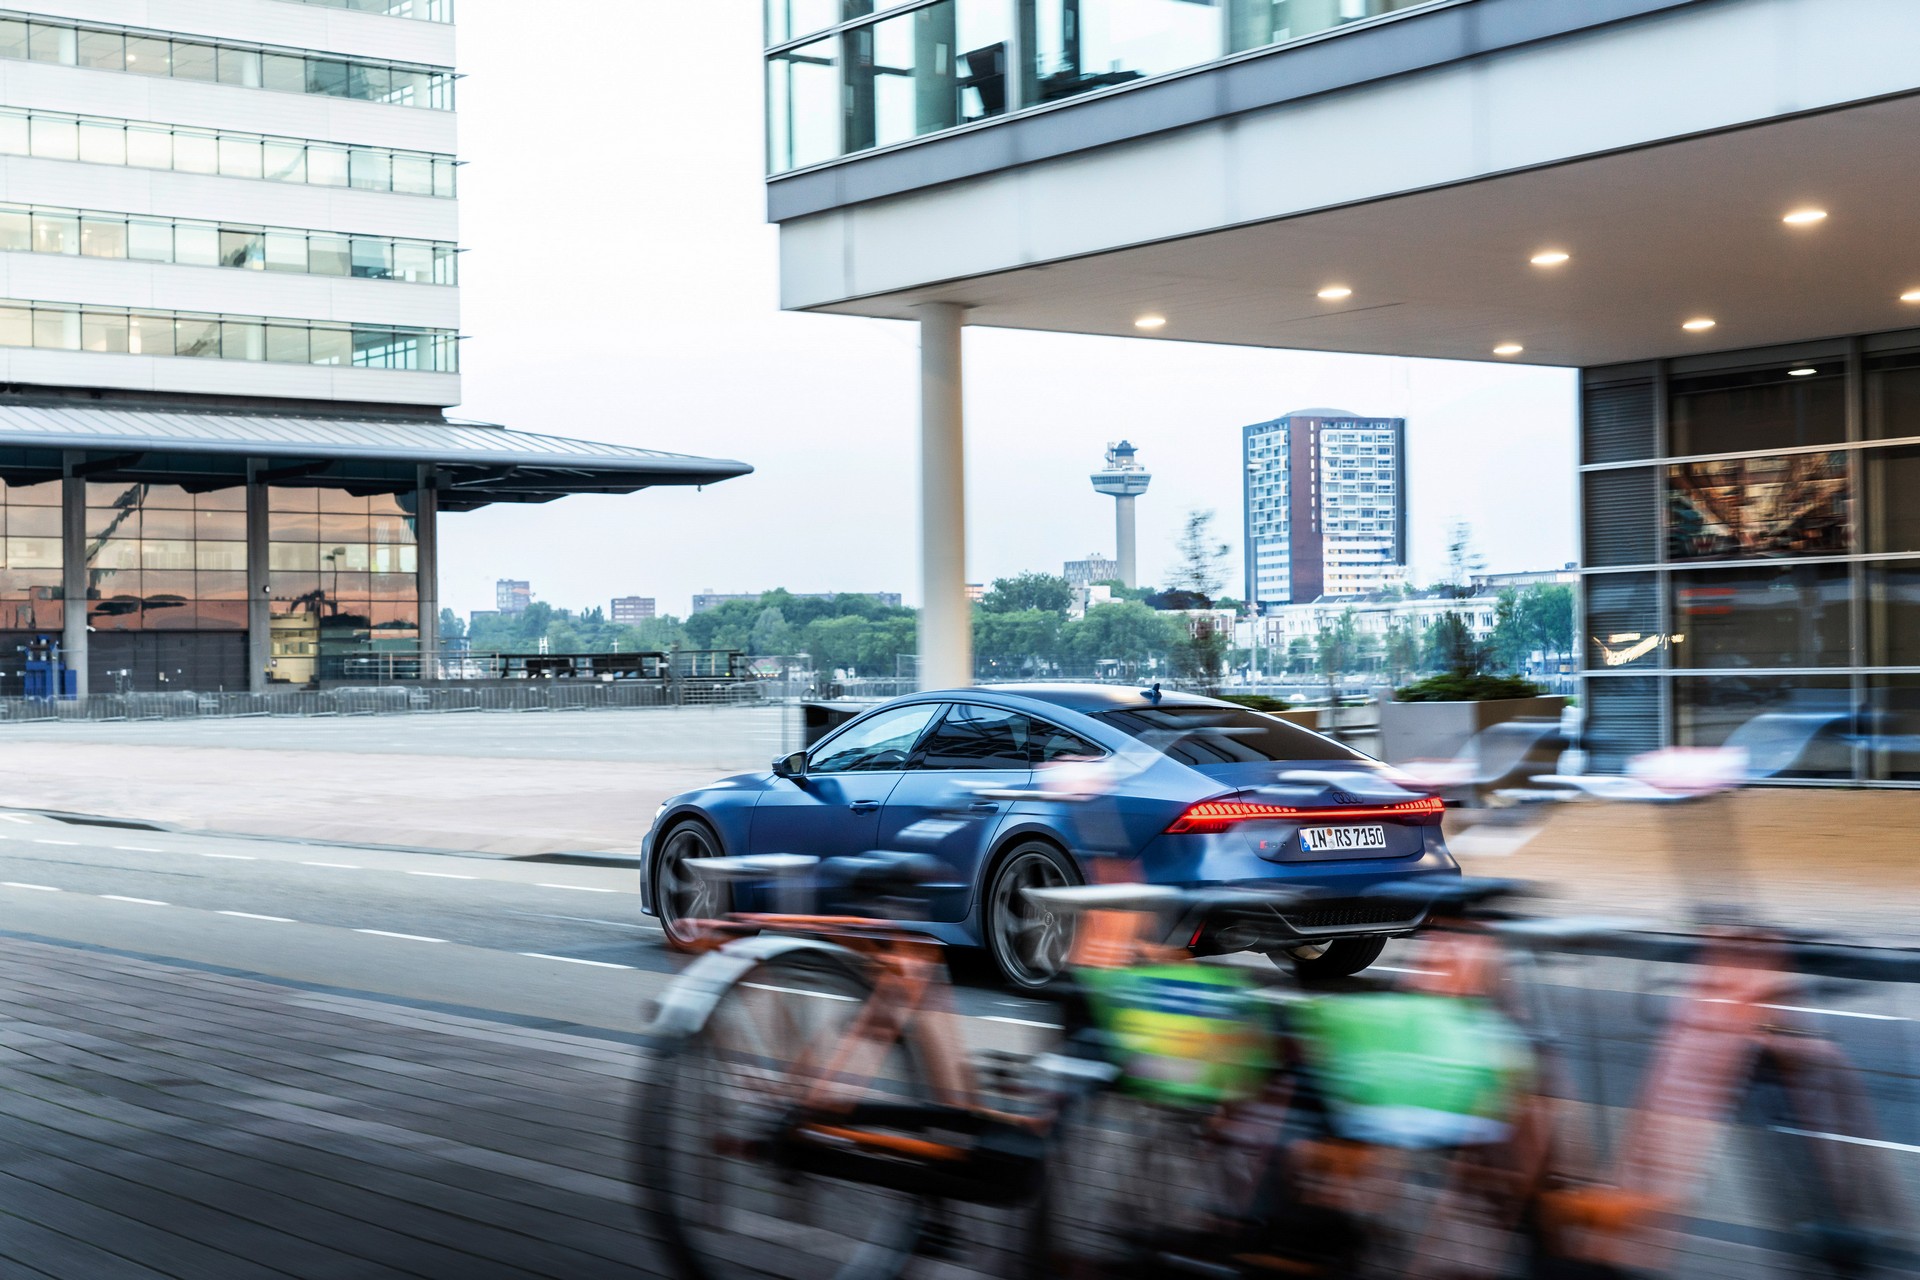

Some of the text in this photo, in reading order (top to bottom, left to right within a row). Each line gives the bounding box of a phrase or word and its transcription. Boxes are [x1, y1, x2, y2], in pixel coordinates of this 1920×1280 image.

[1310, 827, 1384, 848] IN RS 7150
